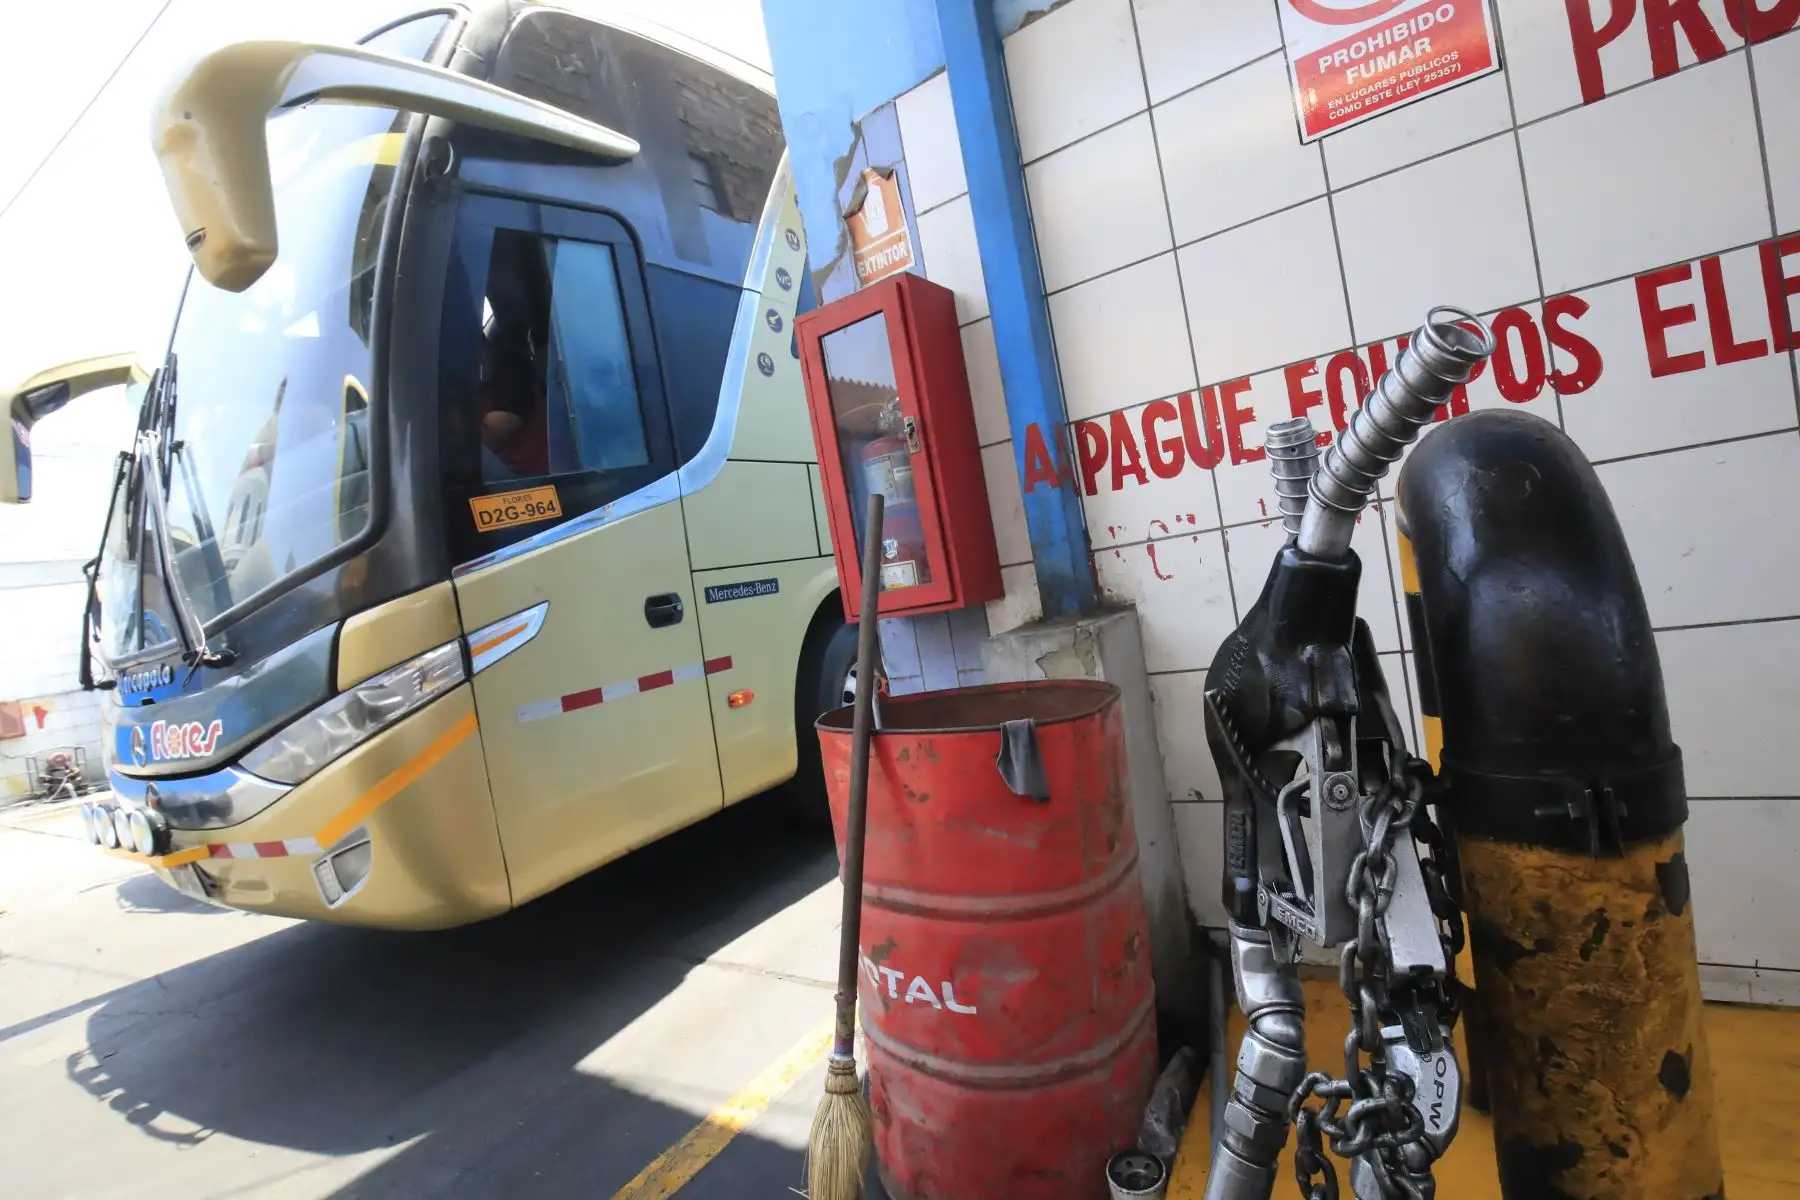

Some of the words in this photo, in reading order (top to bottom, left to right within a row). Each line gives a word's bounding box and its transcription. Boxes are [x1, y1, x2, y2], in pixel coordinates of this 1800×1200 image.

[1318, 3, 1455, 74] PROHIBIDO
[1346, 36, 1433, 84] FUMAR
[1327, 96, 1343, 110] EN
[1345, 76, 1397, 102] LUGARES
[1329, 102, 1362, 120] COMO
[1365, 90, 1393, 106] ESTE
[1396, 79, 1420, 96] (LEY
[1424, 63, 1462, 84] 25357)
[858, 240, 908, 278] EXTINTOR
[1283, 293, 1603, 448] EQPOS
[478, 499, 556, 526] D2G-964
[502, 493, 533, 505] FLORES
[708, 582, 777, 601] Mercedes-Benz
[859, 945, 977, 1014] OTAL
[1429, 1056, 1447, 1130] OPW
